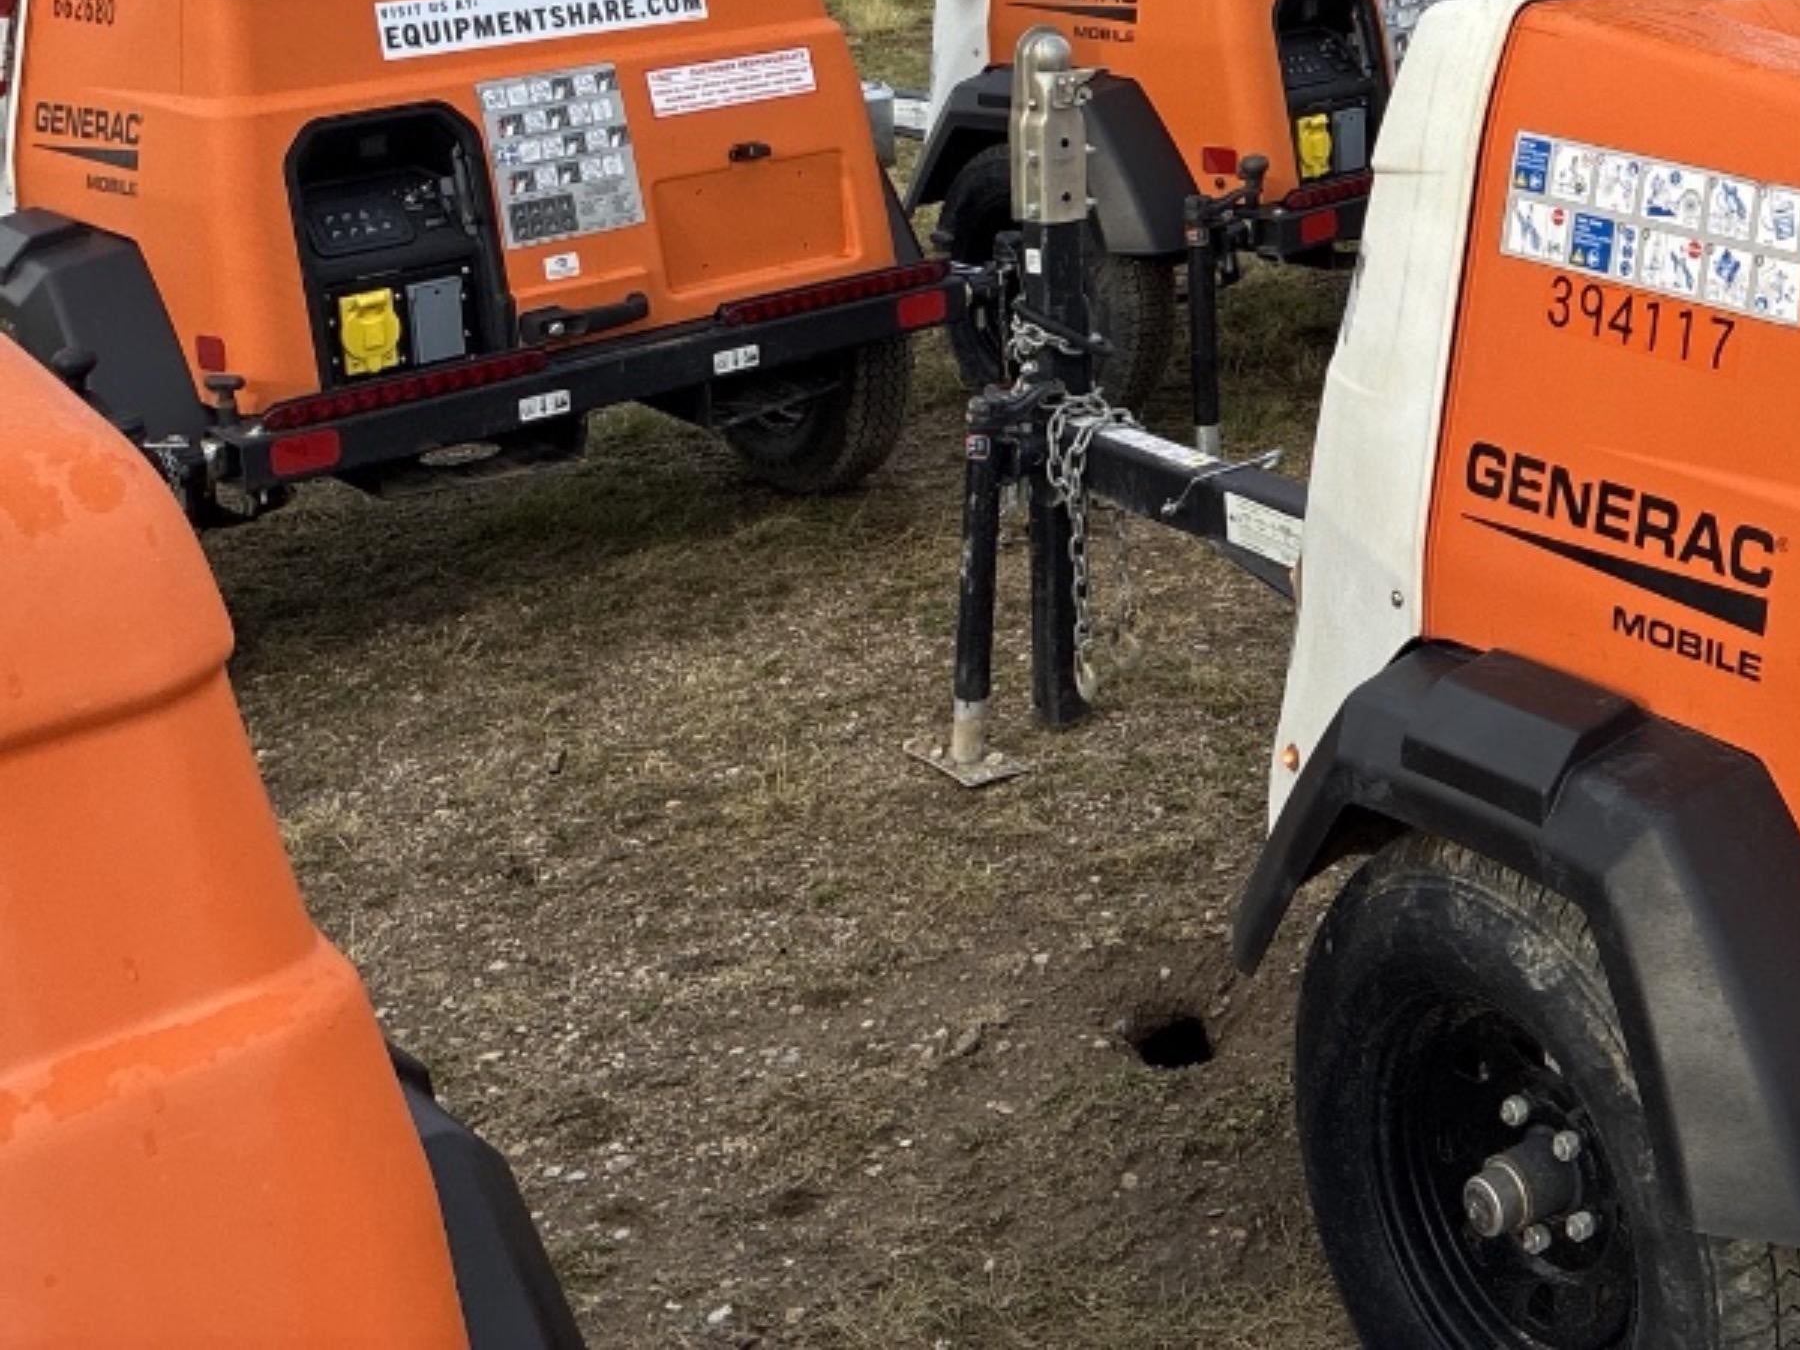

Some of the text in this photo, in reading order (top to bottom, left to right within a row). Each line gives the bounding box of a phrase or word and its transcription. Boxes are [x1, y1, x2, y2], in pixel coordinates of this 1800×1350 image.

[35, 101, 140, 146] GENERAC
[1548, 276, 1735, 369] 394117
[1466, 441, 1776, 589] GENERAC
[1613, 605, 1763, 682] MOBILE
